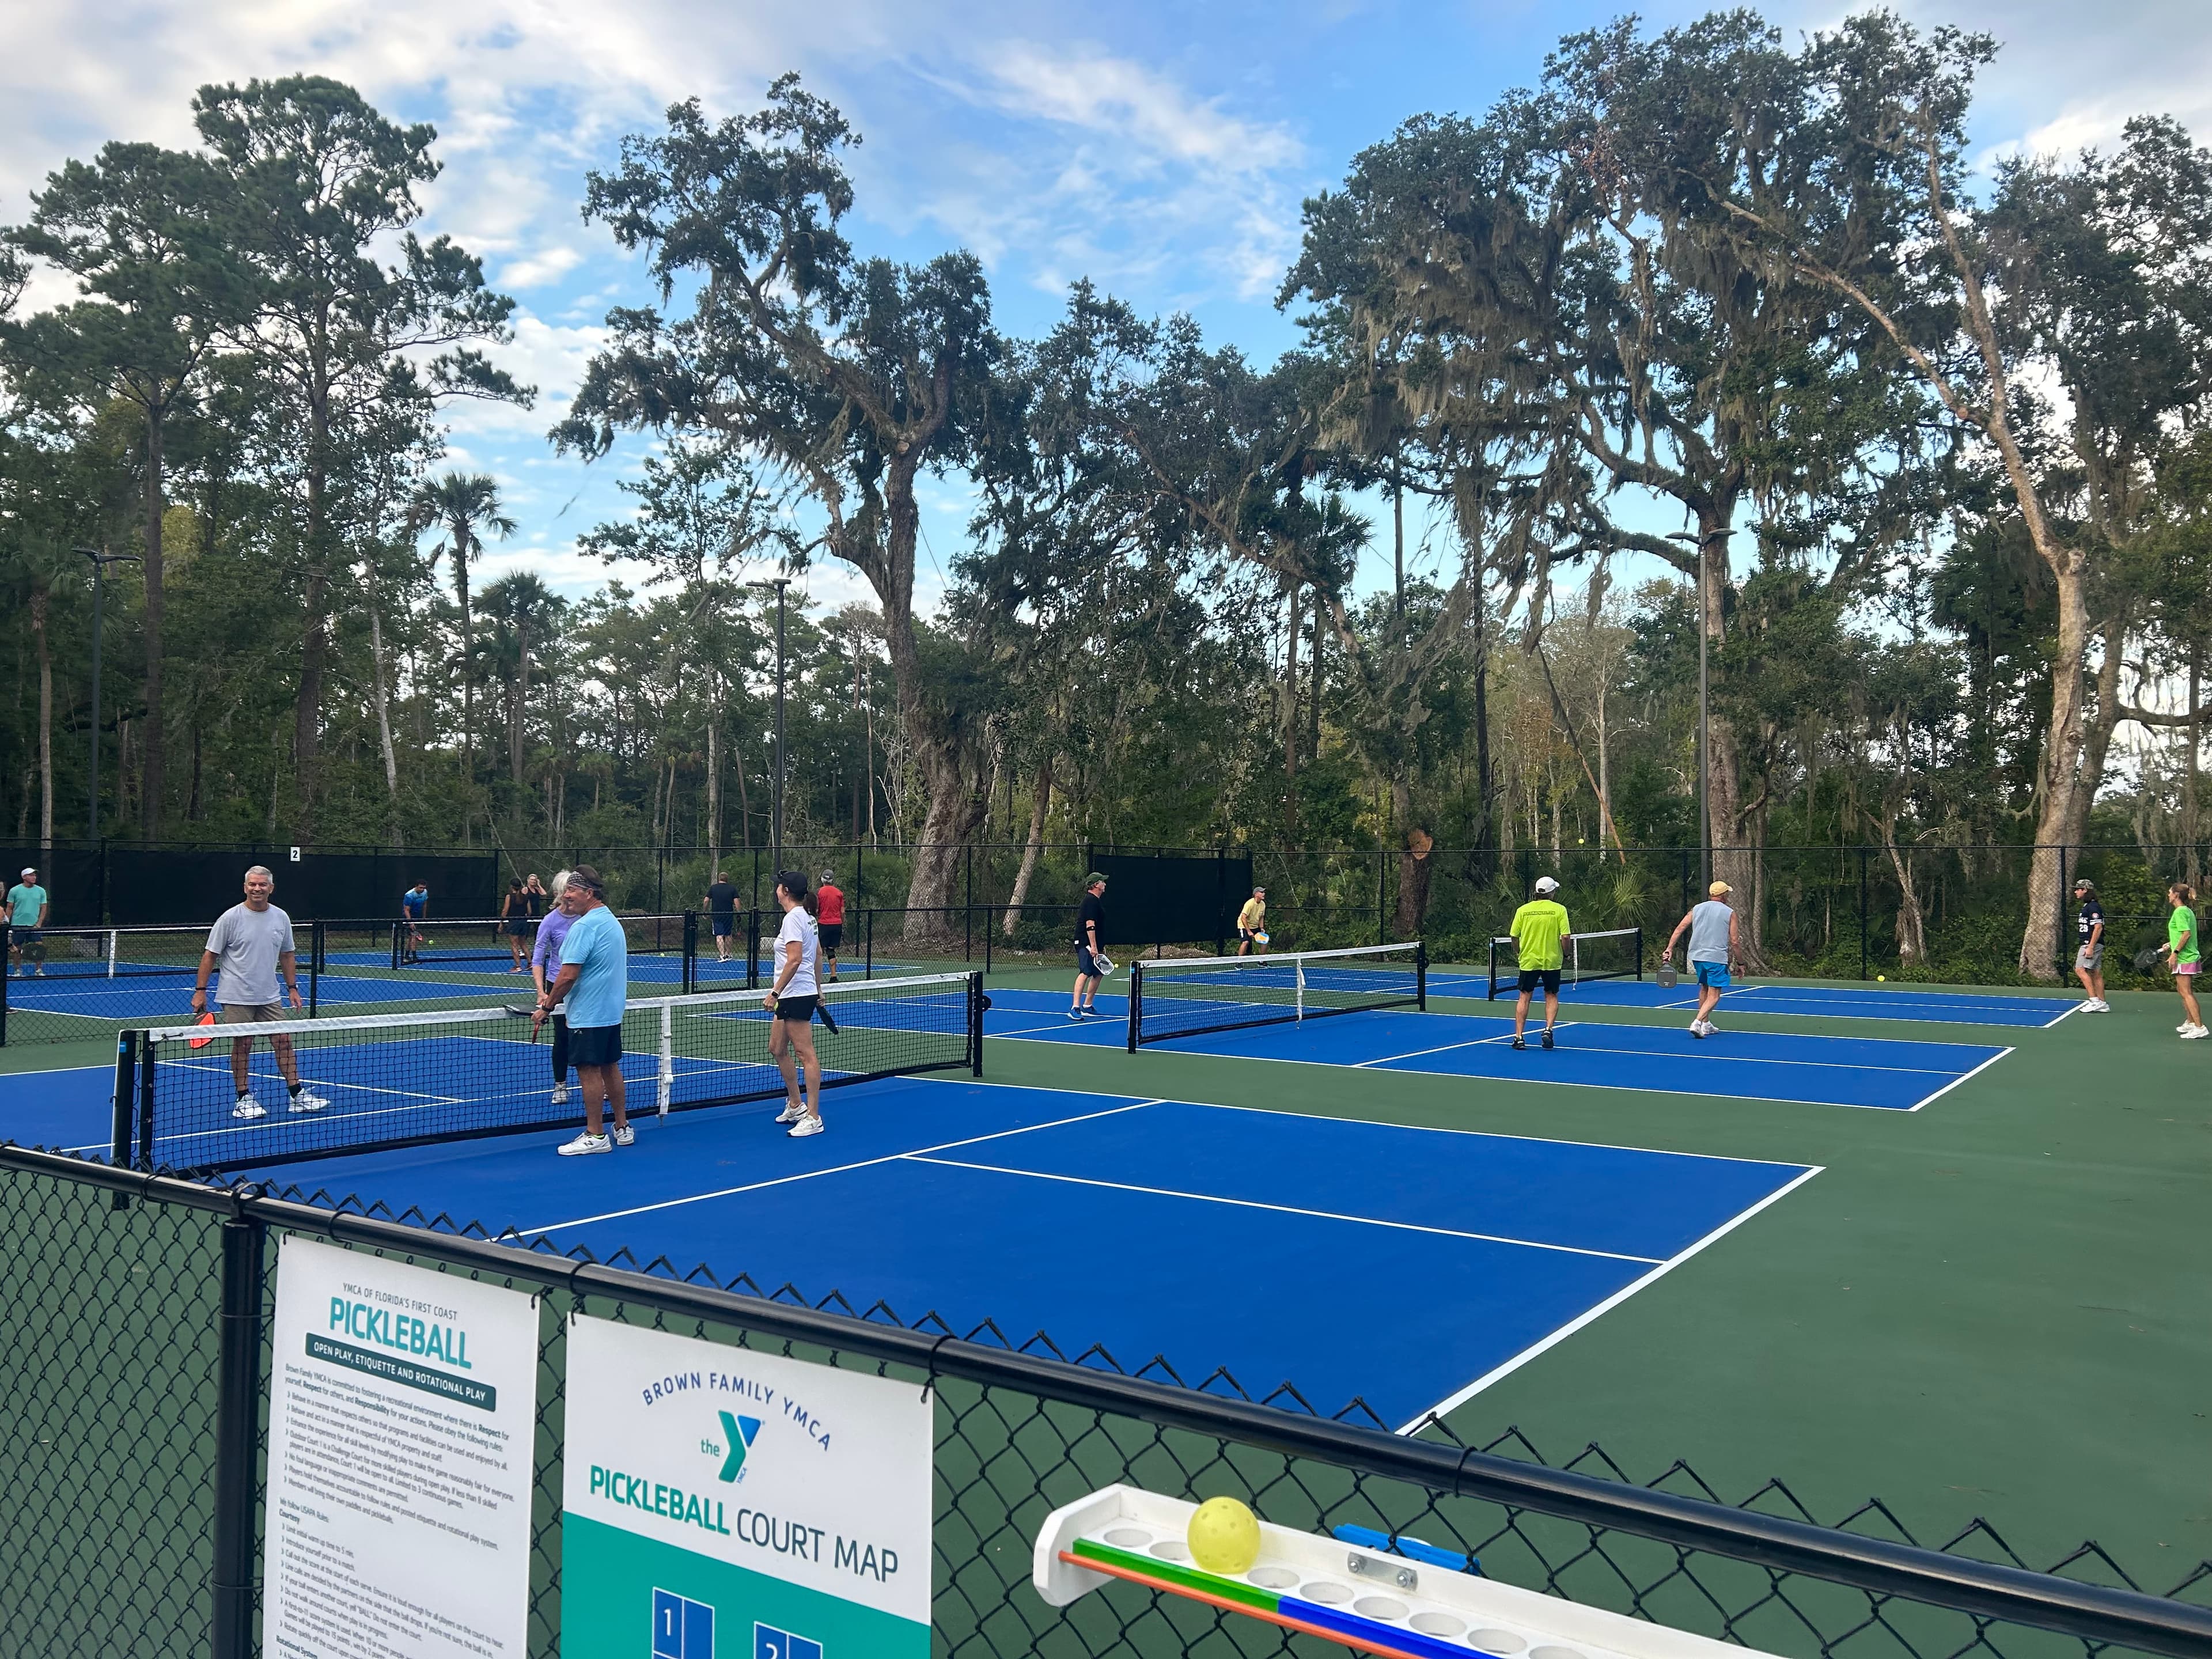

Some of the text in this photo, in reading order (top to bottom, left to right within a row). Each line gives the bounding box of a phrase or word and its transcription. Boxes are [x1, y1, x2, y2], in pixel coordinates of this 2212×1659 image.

[293, 850, 298, 858] 2
[343, 1282, 457, 1320] YMCA OF FLORIDA'S FIRST COAST
[329, 1297, 471, 1369] PICKLEBALL
[314, 1342, 486, 1401] OPEN PLAY, ETIQUETTE AND ROTATIONAL PLAY
[303, 1381, 321, 1392] Respect
[355, 1397, 389, 1415] Responsibility
[313, 1372, 326, 1382] YMCA
[478, 1424, 500, 1438] Respect
[642, 1372, 830, 1452] BROWN FAMILY YMCA
[387, 1437, 400, 1447] YMCA
[700, 1438, 719, 1457] the
[736, 1467, 747, 1484] YMCA
[279, 1509, 300, 1524] Courtesy
[590, 1464, 898, 1583] PICKLEBALL COURT MAP
[664, 1608, 672, 1636] 1
[766, 1643, 778, 1659] 2
